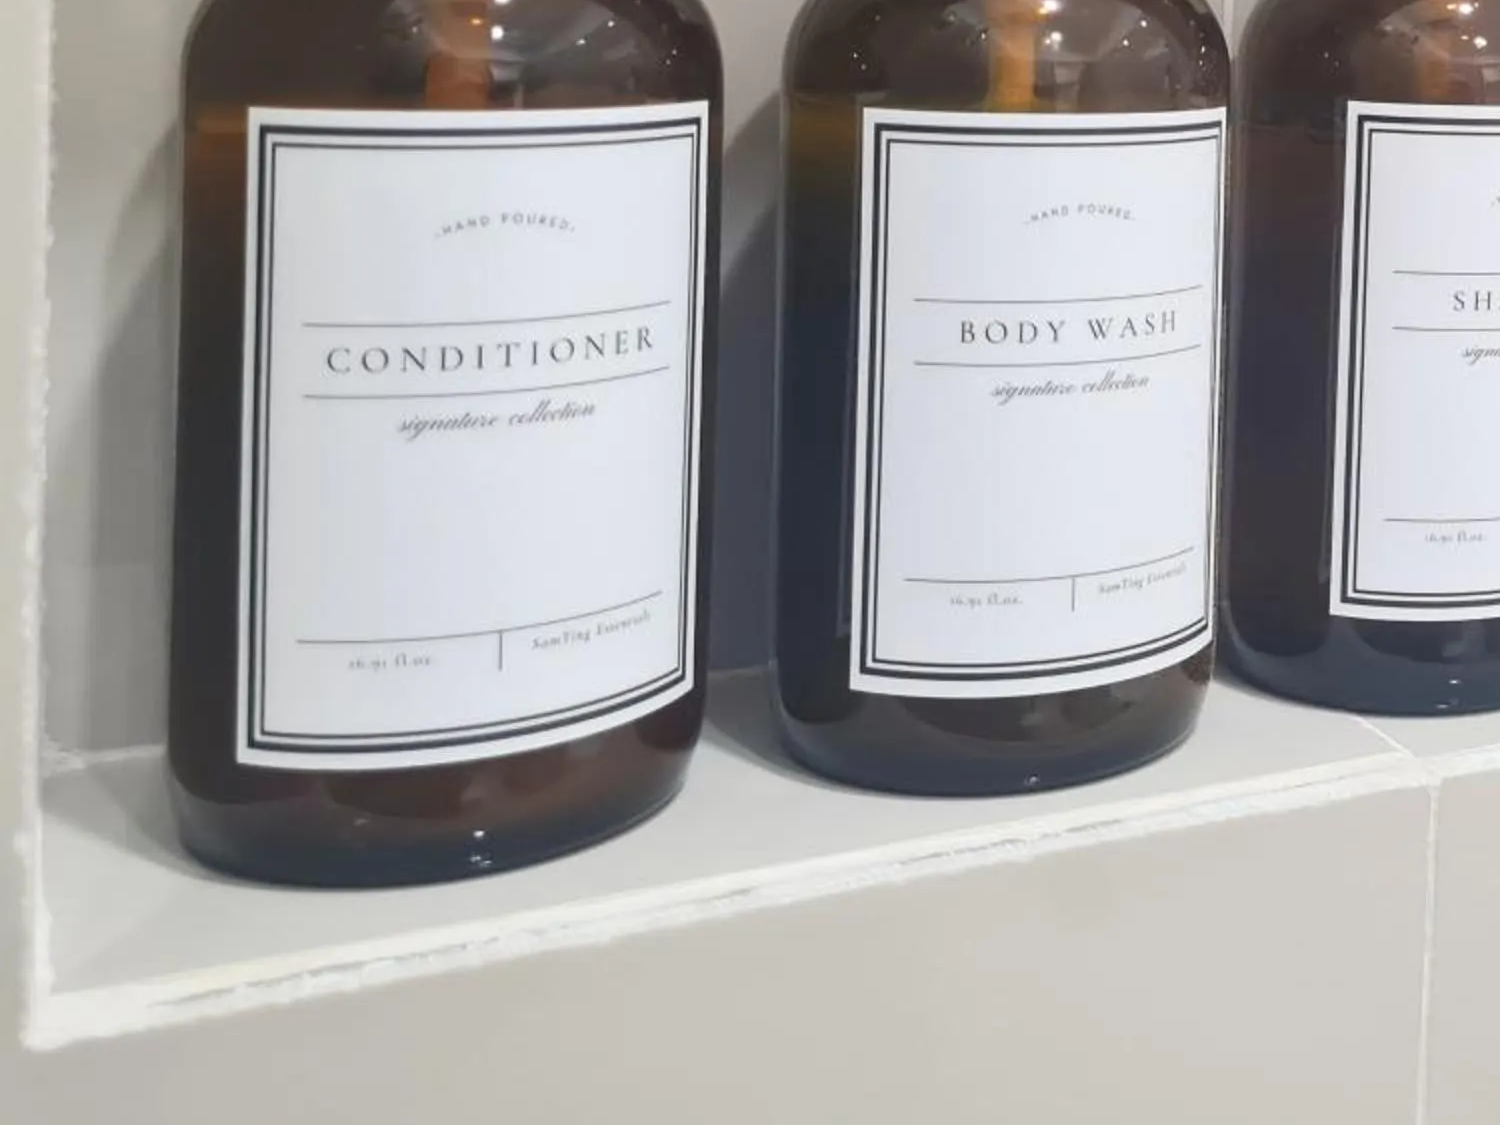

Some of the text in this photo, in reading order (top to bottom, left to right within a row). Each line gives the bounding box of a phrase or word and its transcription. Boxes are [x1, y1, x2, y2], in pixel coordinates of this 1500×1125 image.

[959, 309, 1178, 345] BODY WASH
[325, 325, 655, 375] CONDITIONER
[989, 369, 1150, 406] signature collection
[397, 399, 598, 443] signature collection
